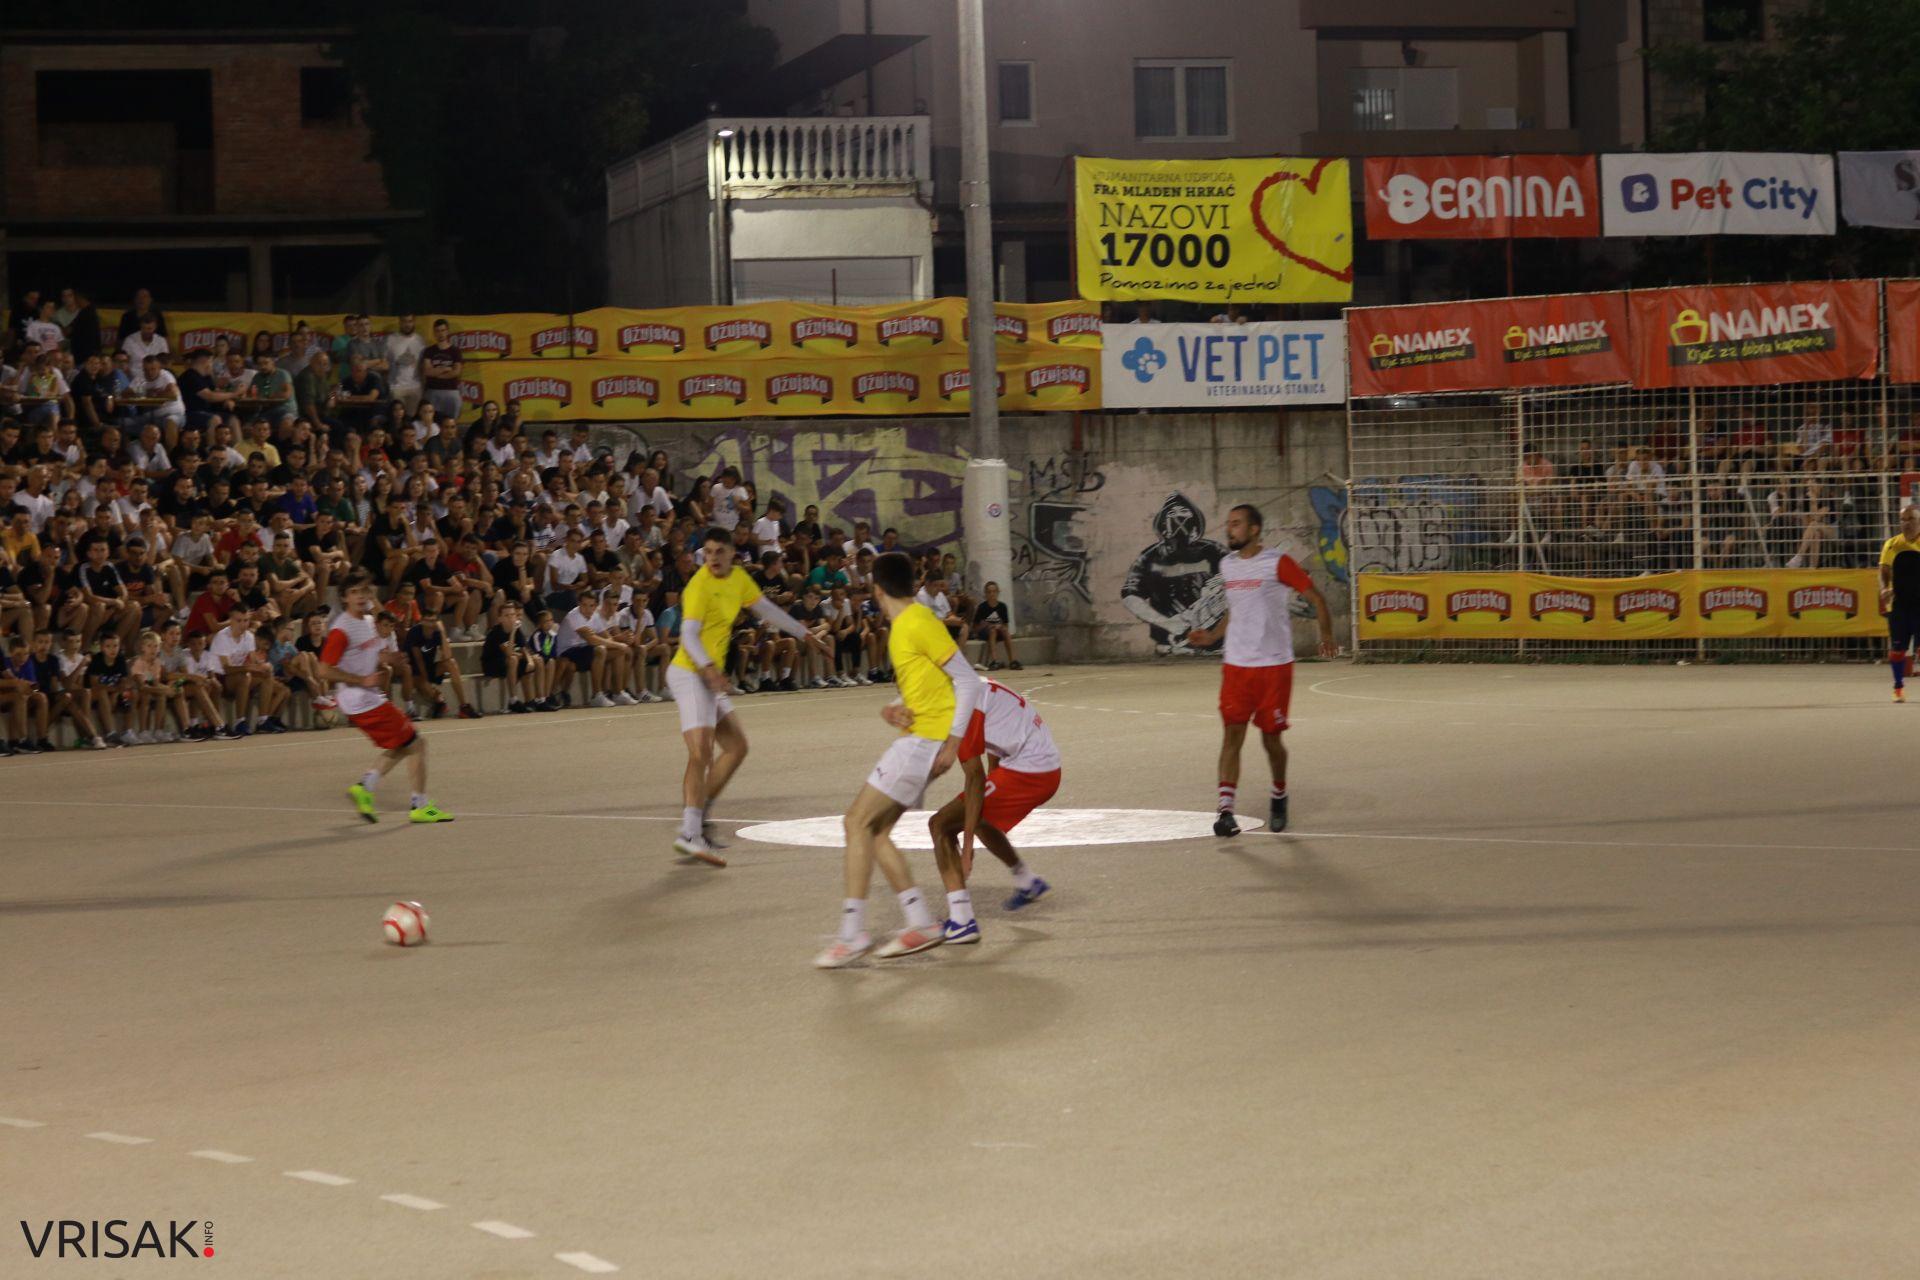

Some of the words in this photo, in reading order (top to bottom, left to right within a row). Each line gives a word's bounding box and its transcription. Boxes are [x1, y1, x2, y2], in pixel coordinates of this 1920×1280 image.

[1094, 184, 1118, 196] FRA
[1123, 185, 1181, 197] MLADEN
[1186, 183, 1235, 197] HRKAĆ
[1379, 174, 1585, 224] BERNINA
[1671, 179, 1733, 210] Pet
[1742, 177, 1818, 219] City
[1099, 202, 1231, 230] NAZOVI
[1100, 232, 1230, 267] 17000
[1099, 272, 1199, 290] Pomozimo
[1204, 273, 1283, 299] zajedno!
[710, 320, 767, 340] Ožujsko
[797, 318, 853, 338] Ožujsko
[883, 317, 939, 337] Ožujsko
[1709, 302, 1830, 342] NAMEX
[1393, 327, 1471, 354] NAMEX
[1527, 320, 1606, 347] NAMEX
[1178, 335, 1248, 382] VET
[1258, 333, 1325, 381] PET
[597, 377, 655, 397] Ožujsko
[684, 376, 741, 397] Ožujsko
[772, 375, 828, 396] Ožujsko
[858, 373, 914, 394] Ožujsko
[1031, 366, 1086, 386] Ožujsko
[509, 377, 567, 399] Ožujsko
[1207, 383, 1281, 397] VETERINARSKA
[1285, 382, 1326, 395] STANICA
[1370, 591, 1424, 612] Ožujsko
[1452, 591, 1507, 612] Ožujsko
[1535, 590, 1590, 612] Ožujsko
[1620, 589, 1675, 611] Ožujsko
[1705, 587, 1763, 610] Ožujsko
[1793, 586, 1853, 609] Ožujsko
